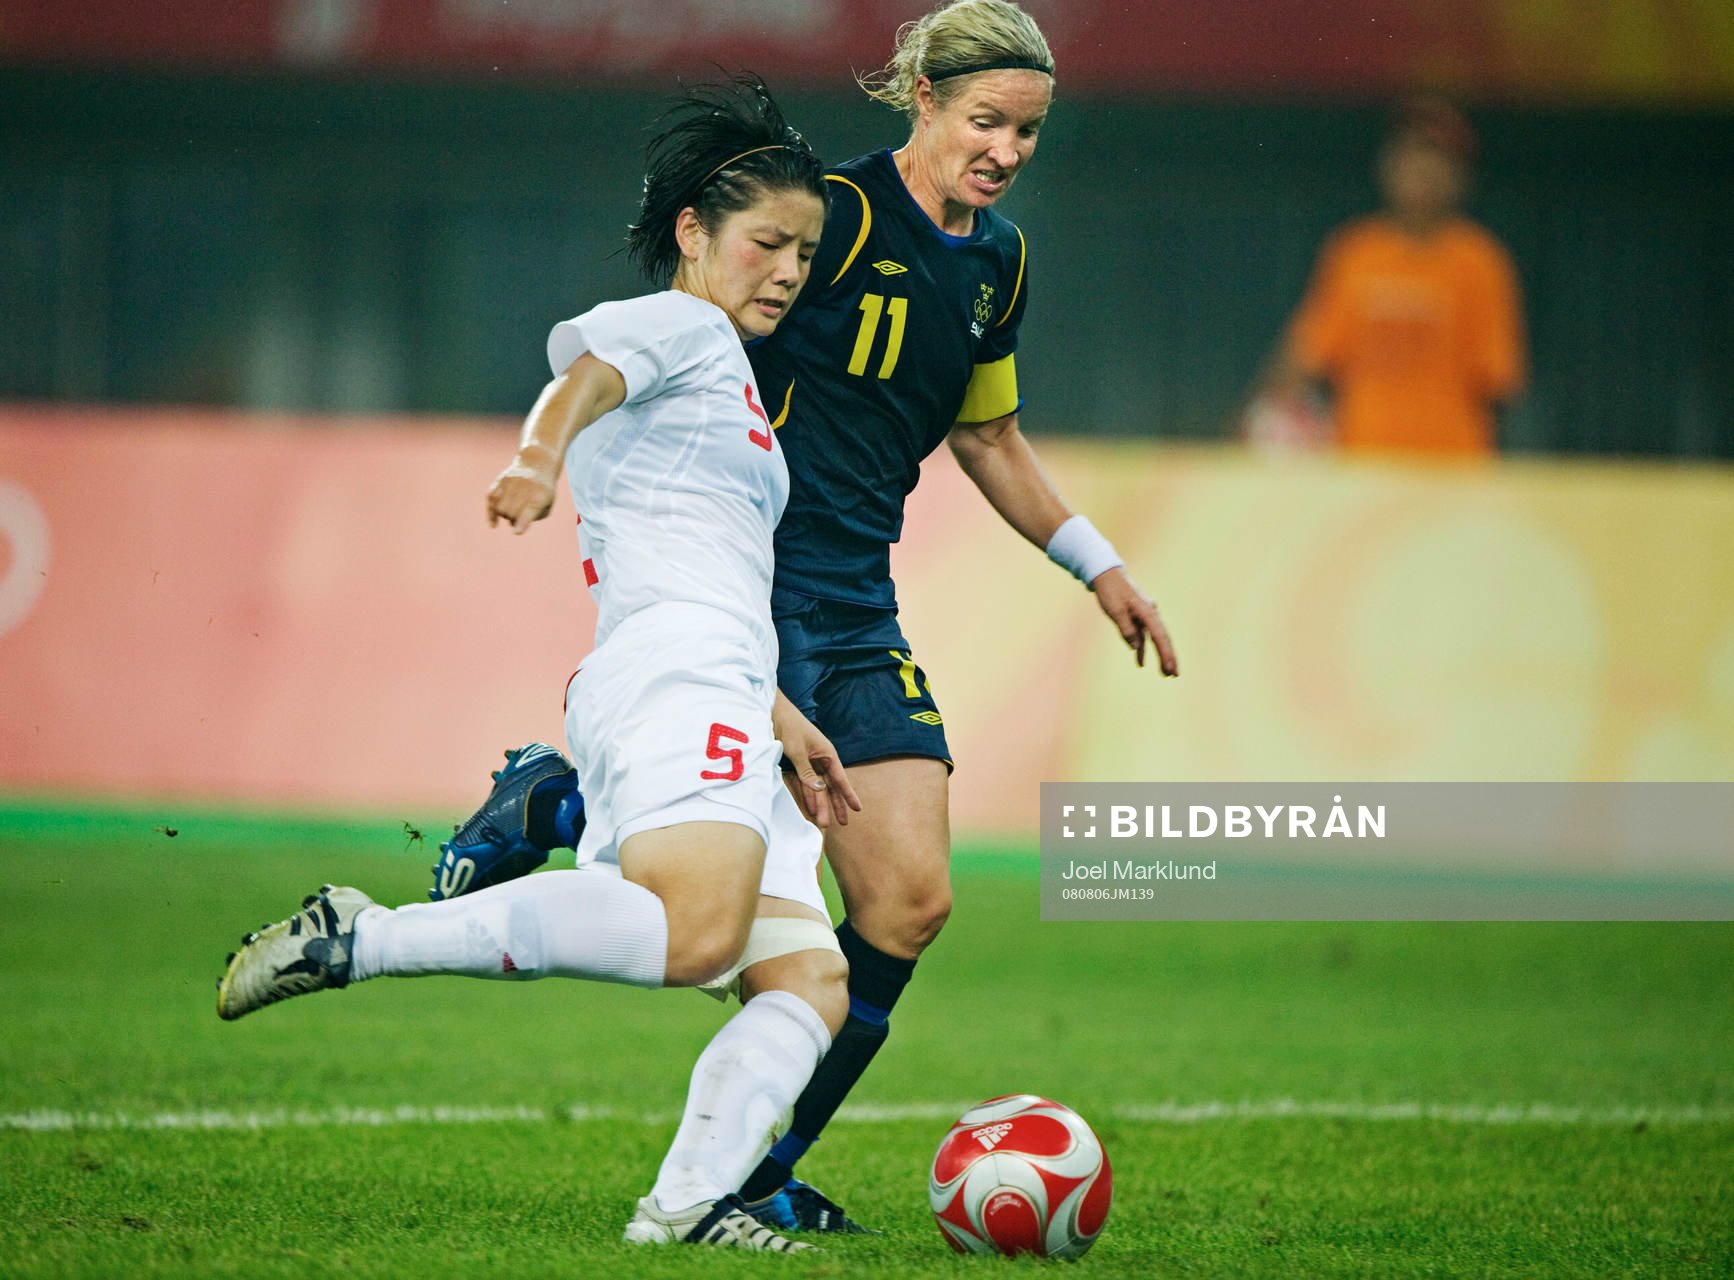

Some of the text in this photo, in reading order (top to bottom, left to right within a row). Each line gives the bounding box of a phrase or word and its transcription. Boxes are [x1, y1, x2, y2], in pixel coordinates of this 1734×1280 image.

[847, 292, 908, 380] 11
[889, 650, 932, 698] 1
[700, 722, 749, 781] 5
